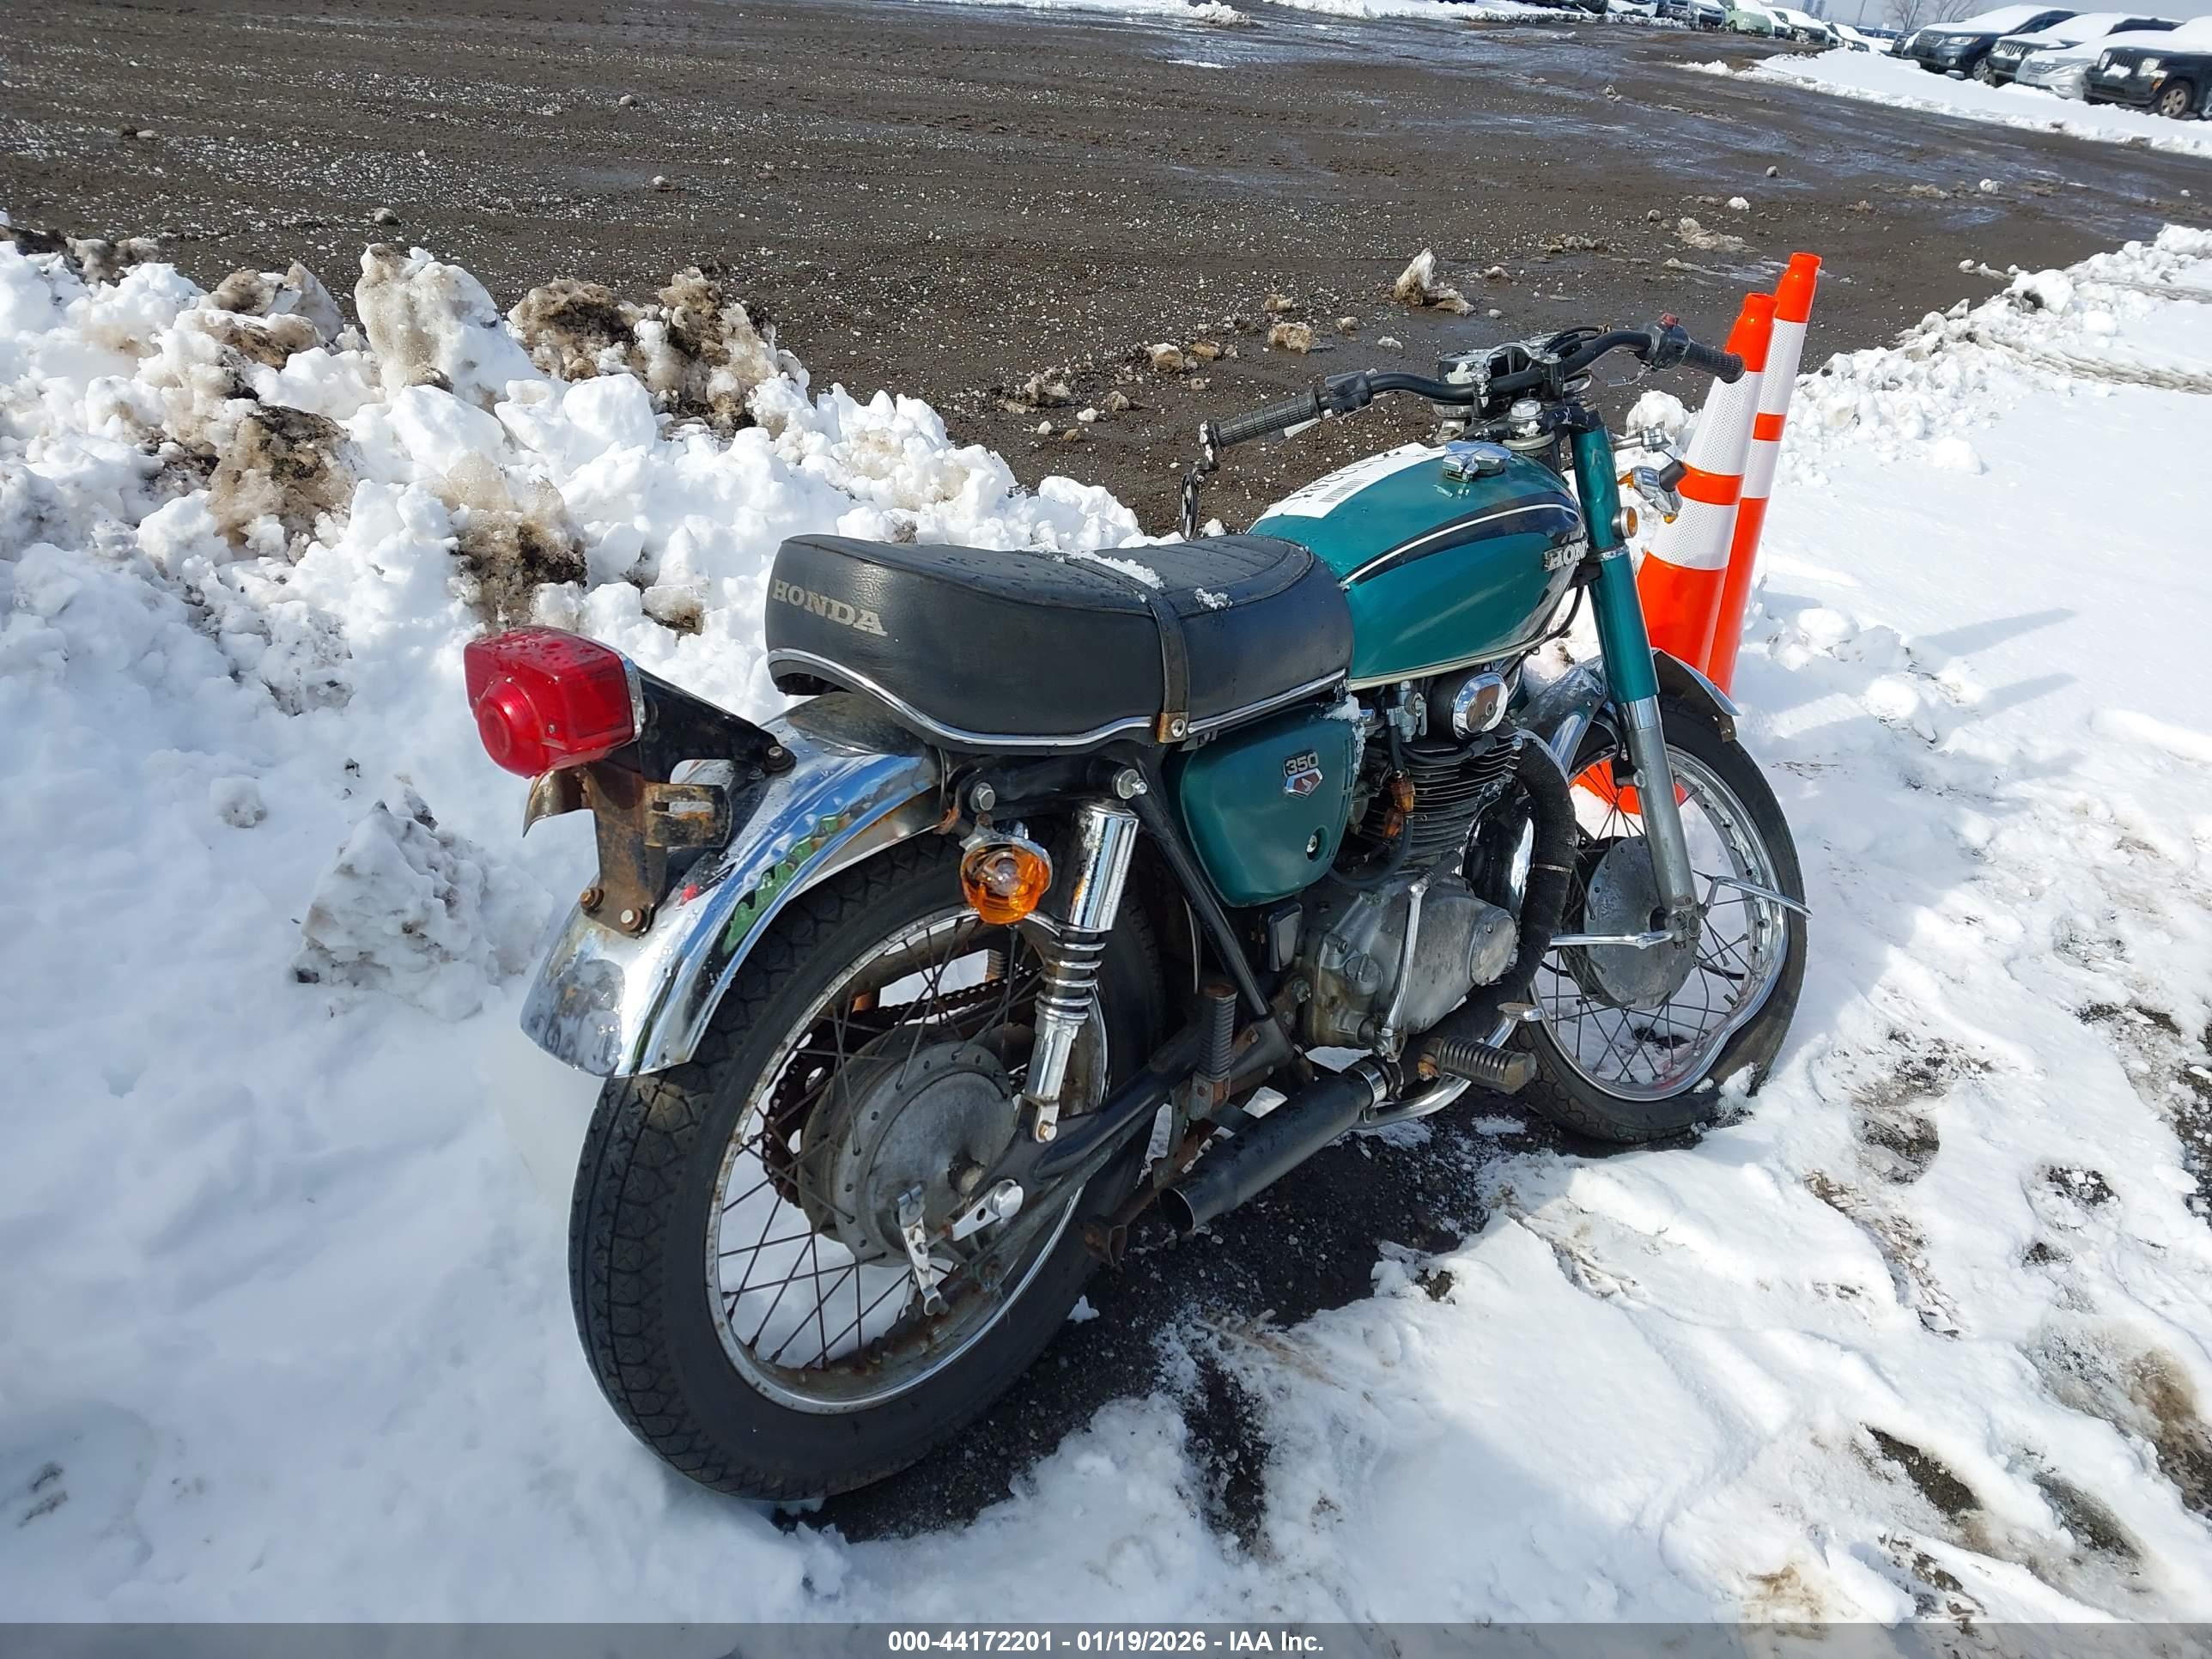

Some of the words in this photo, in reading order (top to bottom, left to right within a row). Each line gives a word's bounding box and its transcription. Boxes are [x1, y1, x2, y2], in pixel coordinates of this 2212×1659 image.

[1543, 539, 1589, 572] HON
[773, 578, 888, 637] HONDA
[1285, 751, 1319, 775] 350
